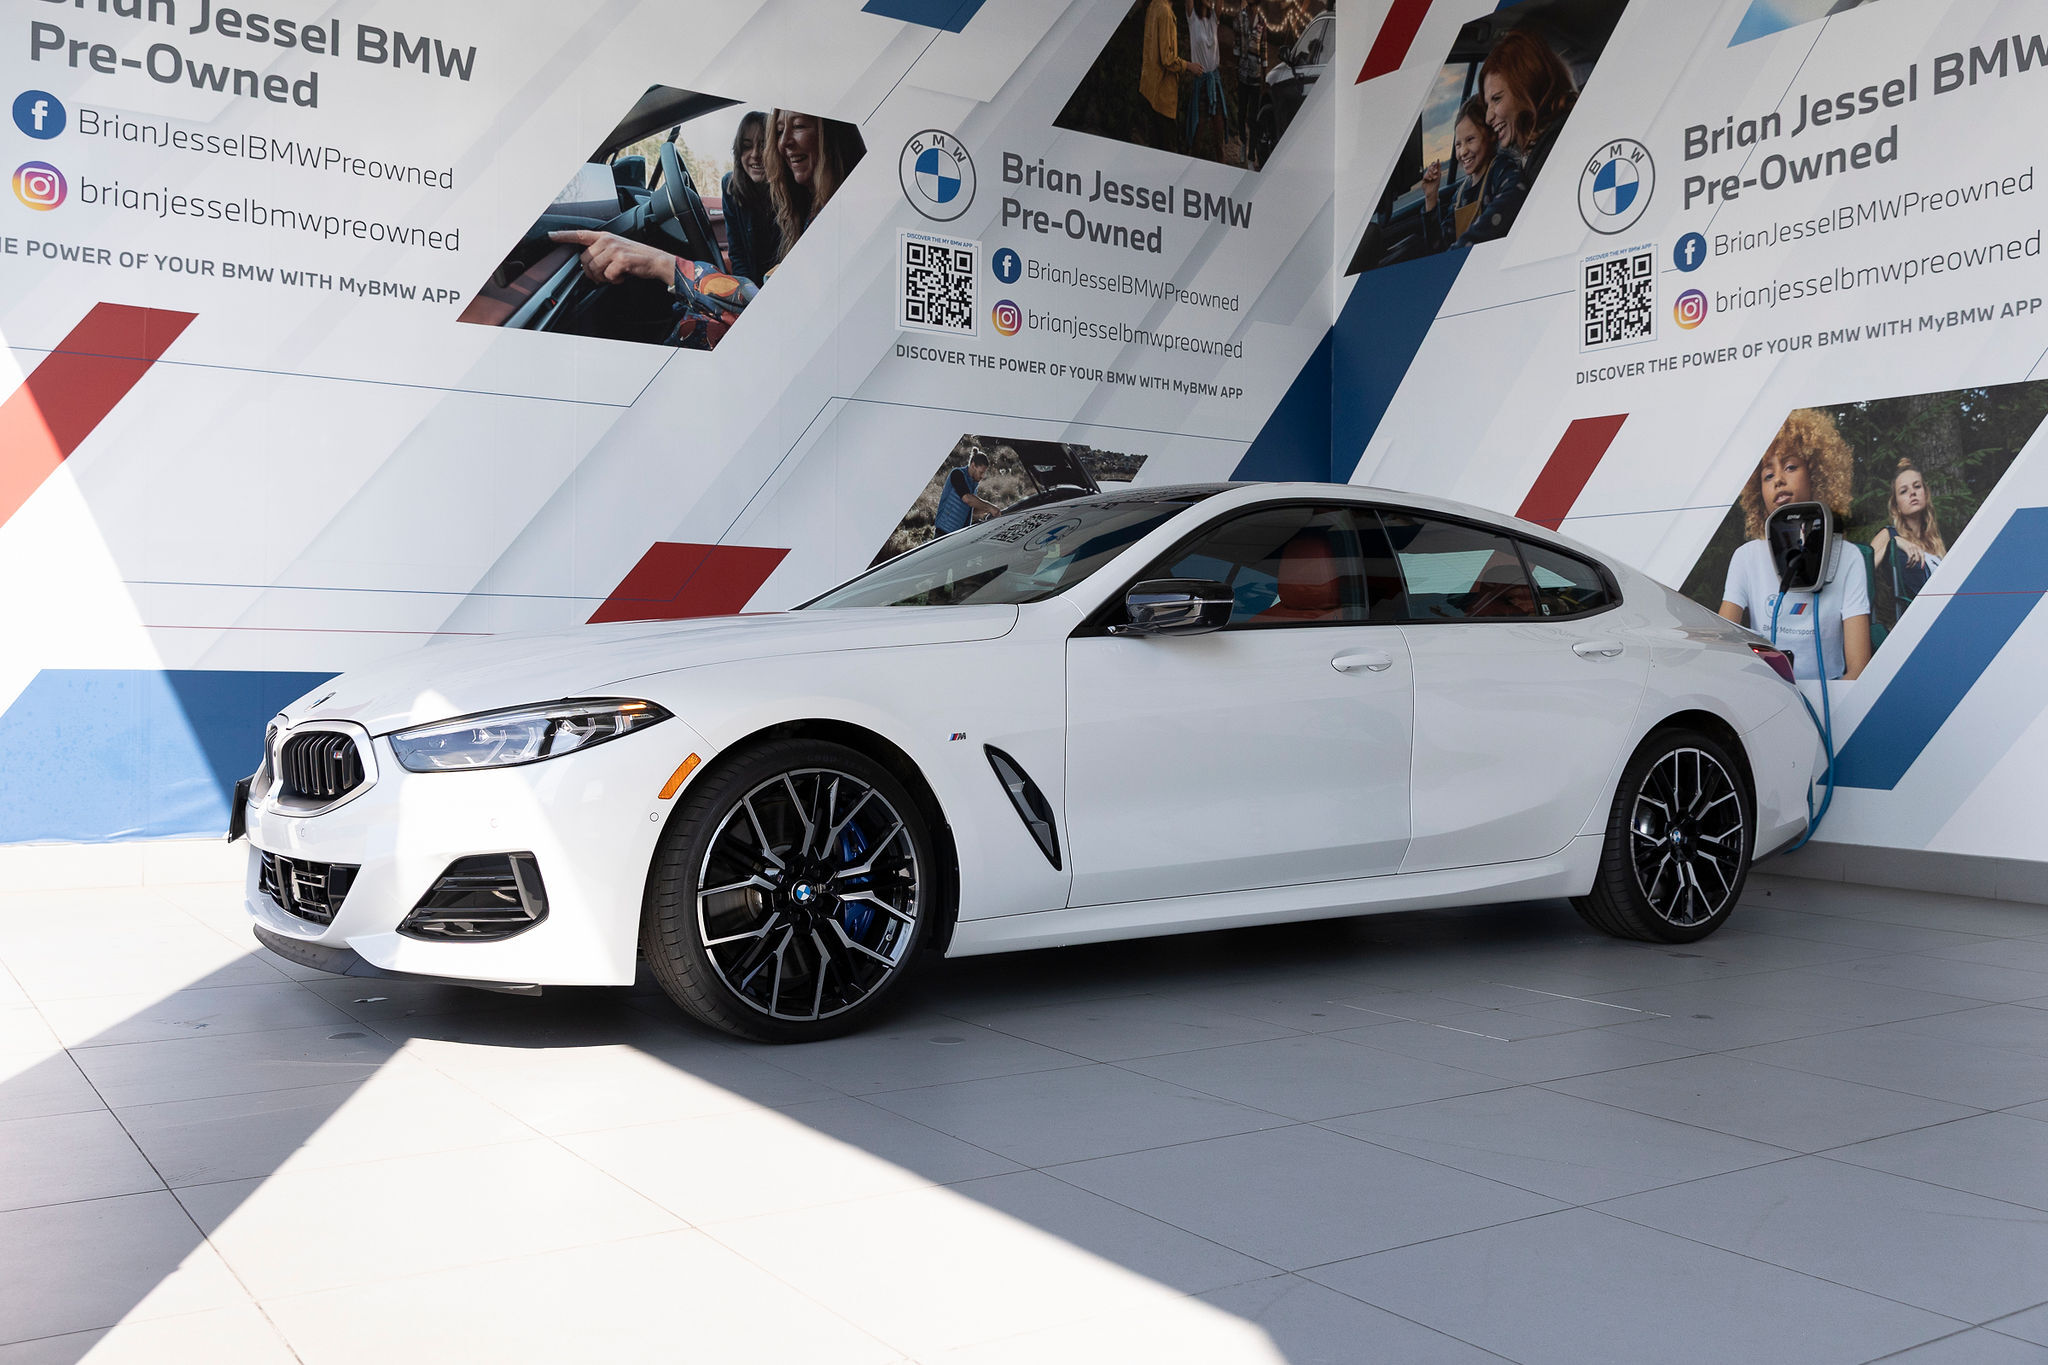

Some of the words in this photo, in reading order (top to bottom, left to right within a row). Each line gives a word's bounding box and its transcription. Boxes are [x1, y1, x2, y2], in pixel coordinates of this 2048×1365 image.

[31, 21, 319, 109] Pre-Owned
[189, 0, 340, 58] Jessel
[357, 24, 477, 82] BMW
[1684, 112, 1782, 161] Brian
[1791, 64, 1917, 138] Jessel
[1934, 34, 2048, 95] BMW
[79, 109, 453, 190] BrianJesselBMWPreowned
[910, 134, 967, 165] BMW
[1588, 143, 1645, 176] BMW
[1684, 124, 1898, 210] Pre-Owned
[81, 176, 460, 251] brianjesselbmwpreowned
[1002, 197, 1163, 254] Pre-Owned
[1003, 152, 1081, 196] Brian
[1088, 169, 1174, 214] Jessel
[1184, 188, 1253, 229] BMW
[1715, 166, 2034, 257] BrianJesselBMWPreowned
[27, 240, 111, 266] POWER
[119, 252, 149, 270] OF
[154, 255, 215, 276] YOUR
[222, 262, 275, 283] BMW
[280, 269, 333, 291] WITH
[339, 276, 417, 300] MyBMW
[422, 287, 460, 305] APP
[907, 233, 931, 241] DISCOVER
[1716, 229, 2041, 313] brianjesselbmwpreowned
[1028, 260, 1239, 312] BrianJesselBMWPreowned
[896, 344, 966, 366] DISCOVER
[968, 353, 996, 369] THE
[999, 357, 1046, 375] POWER
[1049, 363, 1068, 377] OF
[1069, 366, 1103, 382] YOUR
[1106, 371, 1137, 387] BMW
[1139, 375, 1170, 391] WITH
[1173, 379, 1218, 397] MyBMW
[1220, 386, 1244, 399] APP
[1028, 309, 1243, 358] brianjesselbmwpreowned
[1576, 362, 1645, 385] DISCOVER
[1648, 356, 1678, 373] THE
[1682, 347, 1738, 368] POWER
[1742, 342, 1764, 359] OF
[1767, 335, 1813, 354] YOUR
[1818, 329, 1861, 347] BMW
[1865, 318, 1912, 339] WITH
[1918, 305, 1994, 333] MyBMW
[2000, 298, 2043, 319] APP
